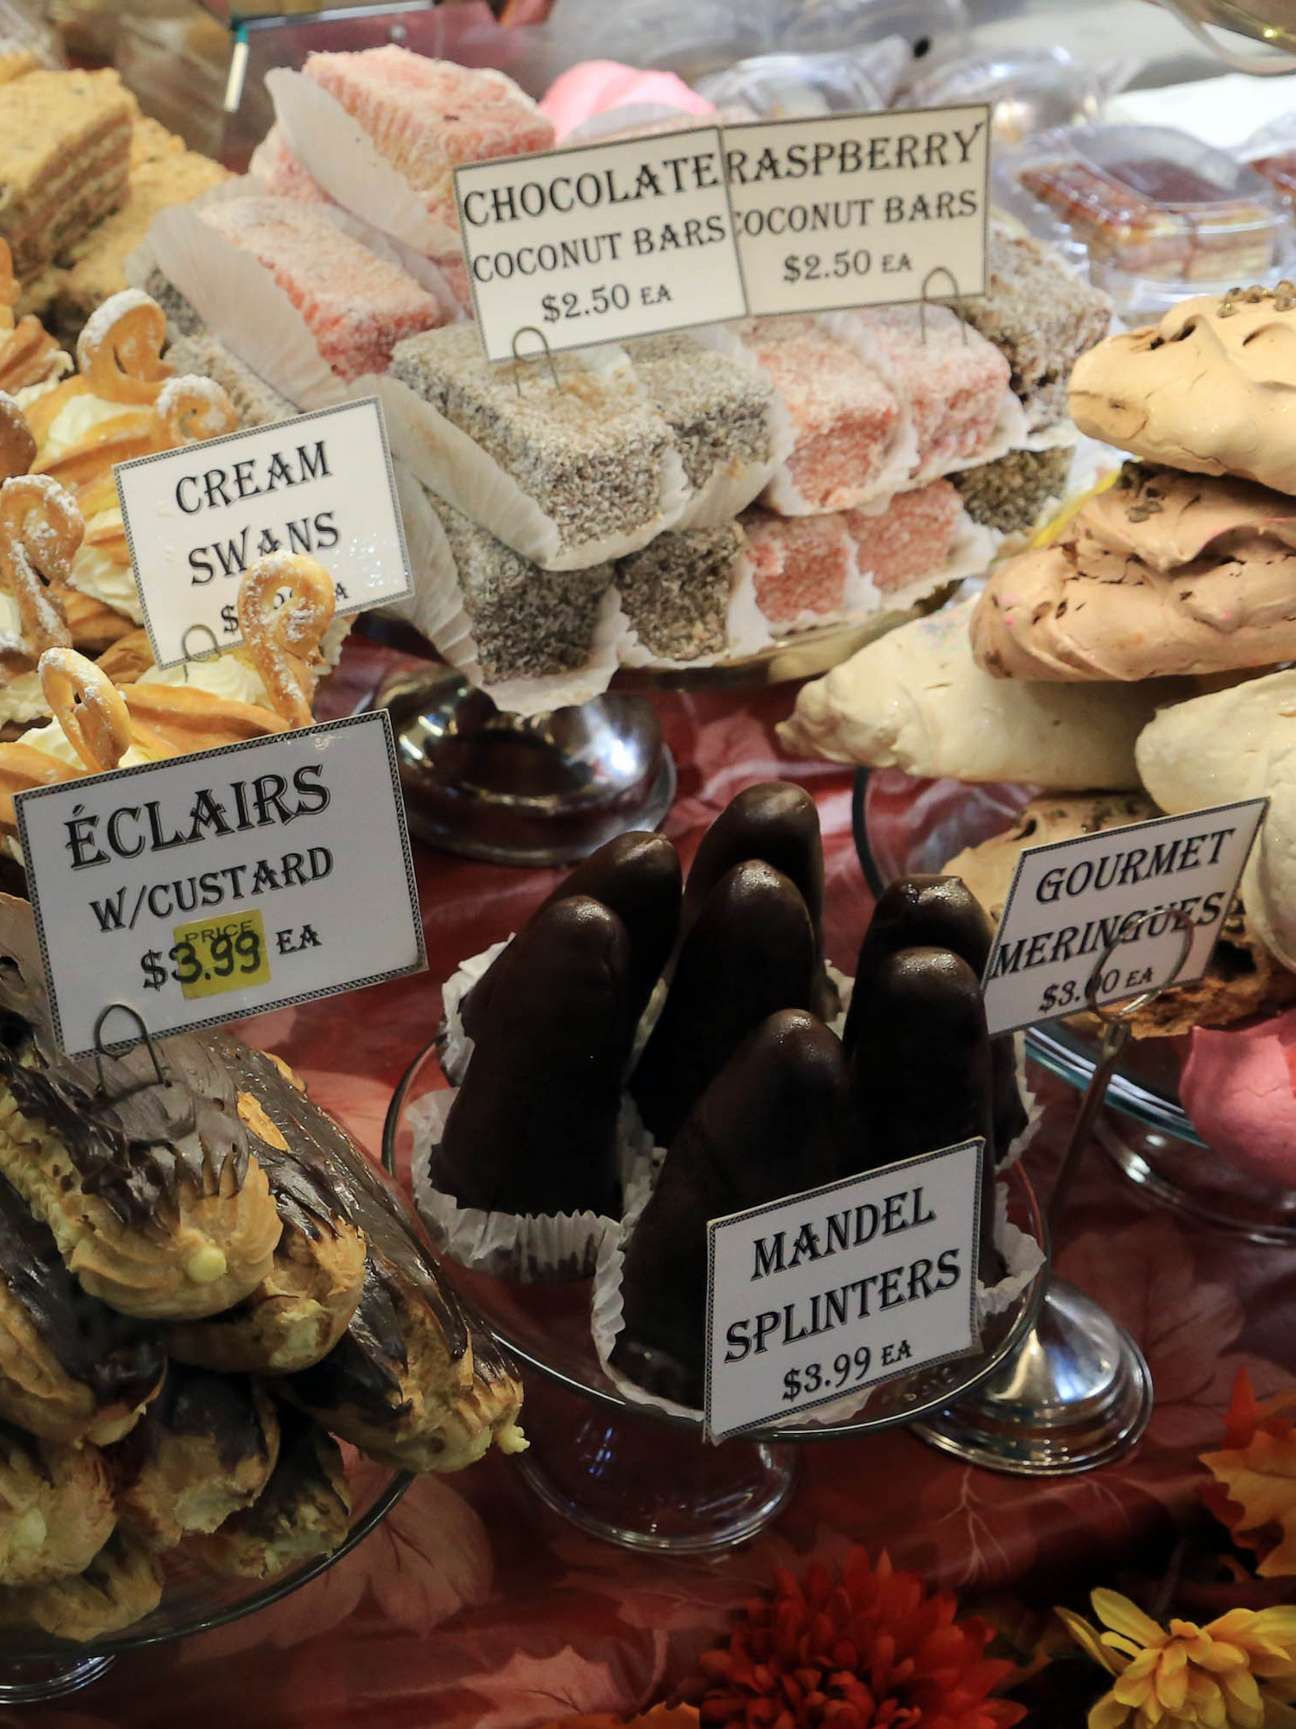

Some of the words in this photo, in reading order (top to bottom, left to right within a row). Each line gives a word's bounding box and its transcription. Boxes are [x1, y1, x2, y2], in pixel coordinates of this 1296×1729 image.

[463, 152, 720, 227] CHOCOLATE
[726, 122, 984, 186] RASPBERRY
[884, 189, 978, 225] BARS
[472, 231, 623, 283] COCONUT
[633, 215, 726, 256] BARS
[783, 249, 872, 283] $2.50
[881, 252, 913, 274] EA
[541, 283, 630, 323] $2.50
[640, 284, 673, 306] EA
[175, 440, 333, 514] CREAM
[188, 511, 339, 586] SWANS
[64, 764, 332, 871] ÉCLAIRS
[88, 845, 334, 933] W/CUSTARD
[1036, 828, 1237, 904] GOURMET
[140, 930, 261, 992] $3.99
[276, 924, 323, 955] EA
[184, 920, 253, 944] PRICE
[990, 891, 1226, 980] MERINGUES
[1124, 967, 1152, 988] EA
[750, 1186, 937, 1282] MANDEL
[724, 1248, 962, 1363] SPLINTERS
[782, 1346, 872, 1402] $3.99
[881, 1339, 913, 1367] EA
